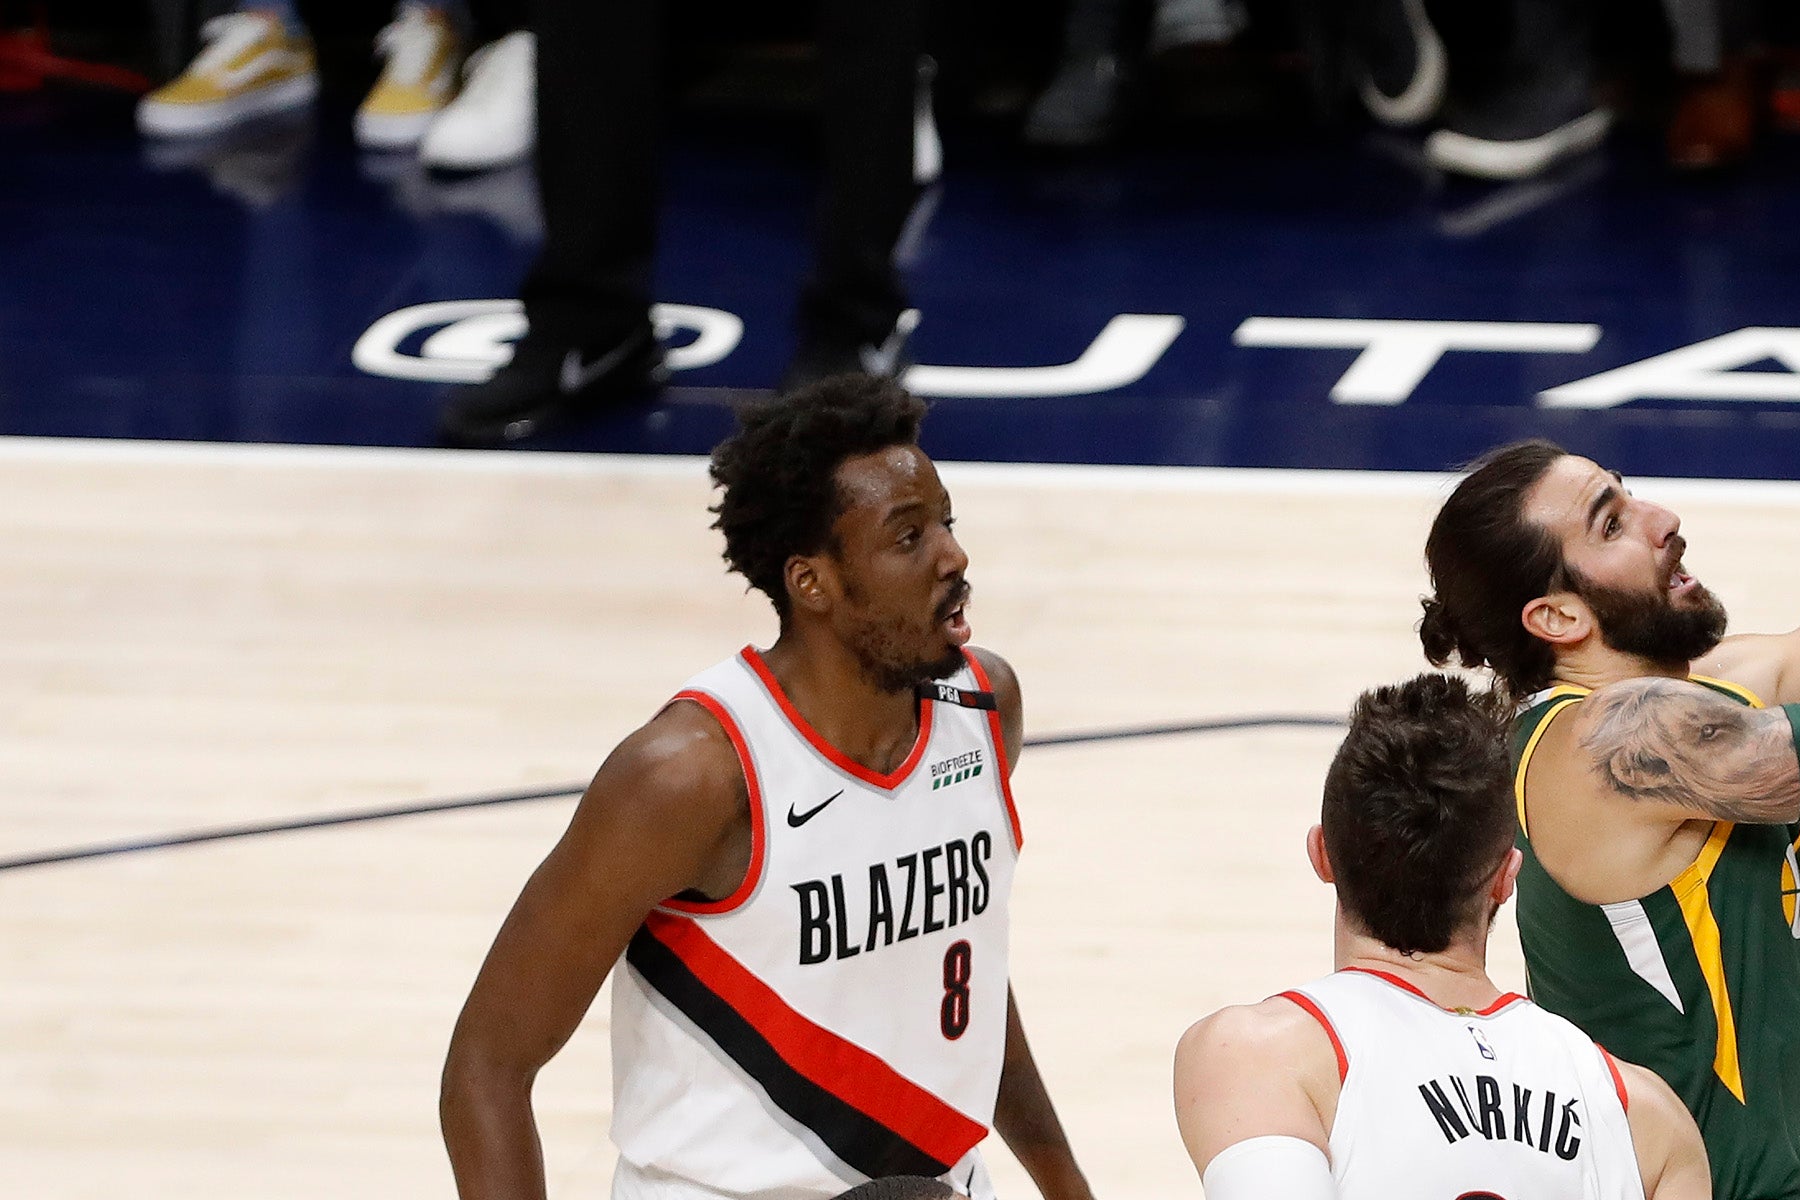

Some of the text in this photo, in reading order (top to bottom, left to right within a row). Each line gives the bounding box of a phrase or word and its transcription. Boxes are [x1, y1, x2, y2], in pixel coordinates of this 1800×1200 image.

[938, 685, 961, 704] PGA
[930, 749, 983, 777] BIOFREEZE
[789, 830, 991, 965] BLAZERS
[940, 938, 972, 1041] 8
[1418, 1074, 1582, 1161] NURKIĆ
